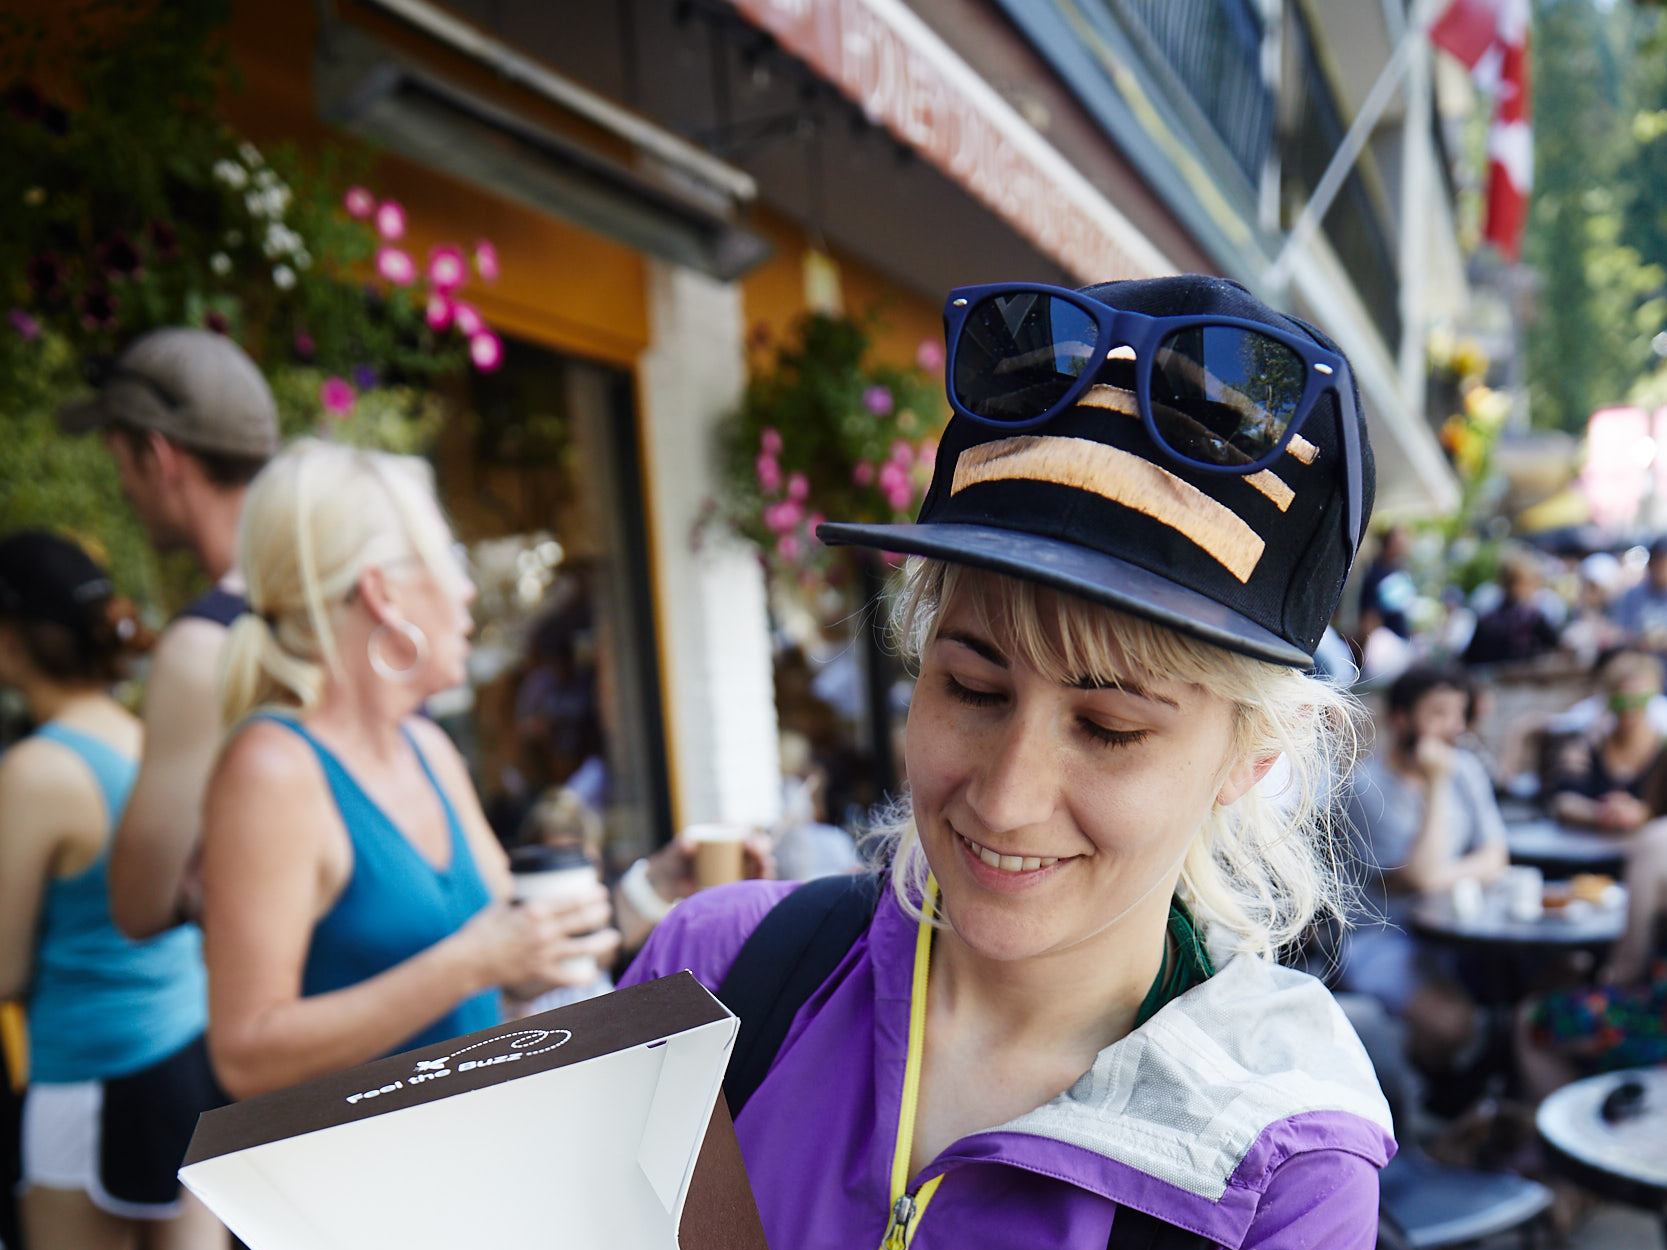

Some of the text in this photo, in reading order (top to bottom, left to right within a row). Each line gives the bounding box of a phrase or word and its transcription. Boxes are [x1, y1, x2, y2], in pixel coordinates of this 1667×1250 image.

[346, 1053, 523, 1104] Feel the Buzz
